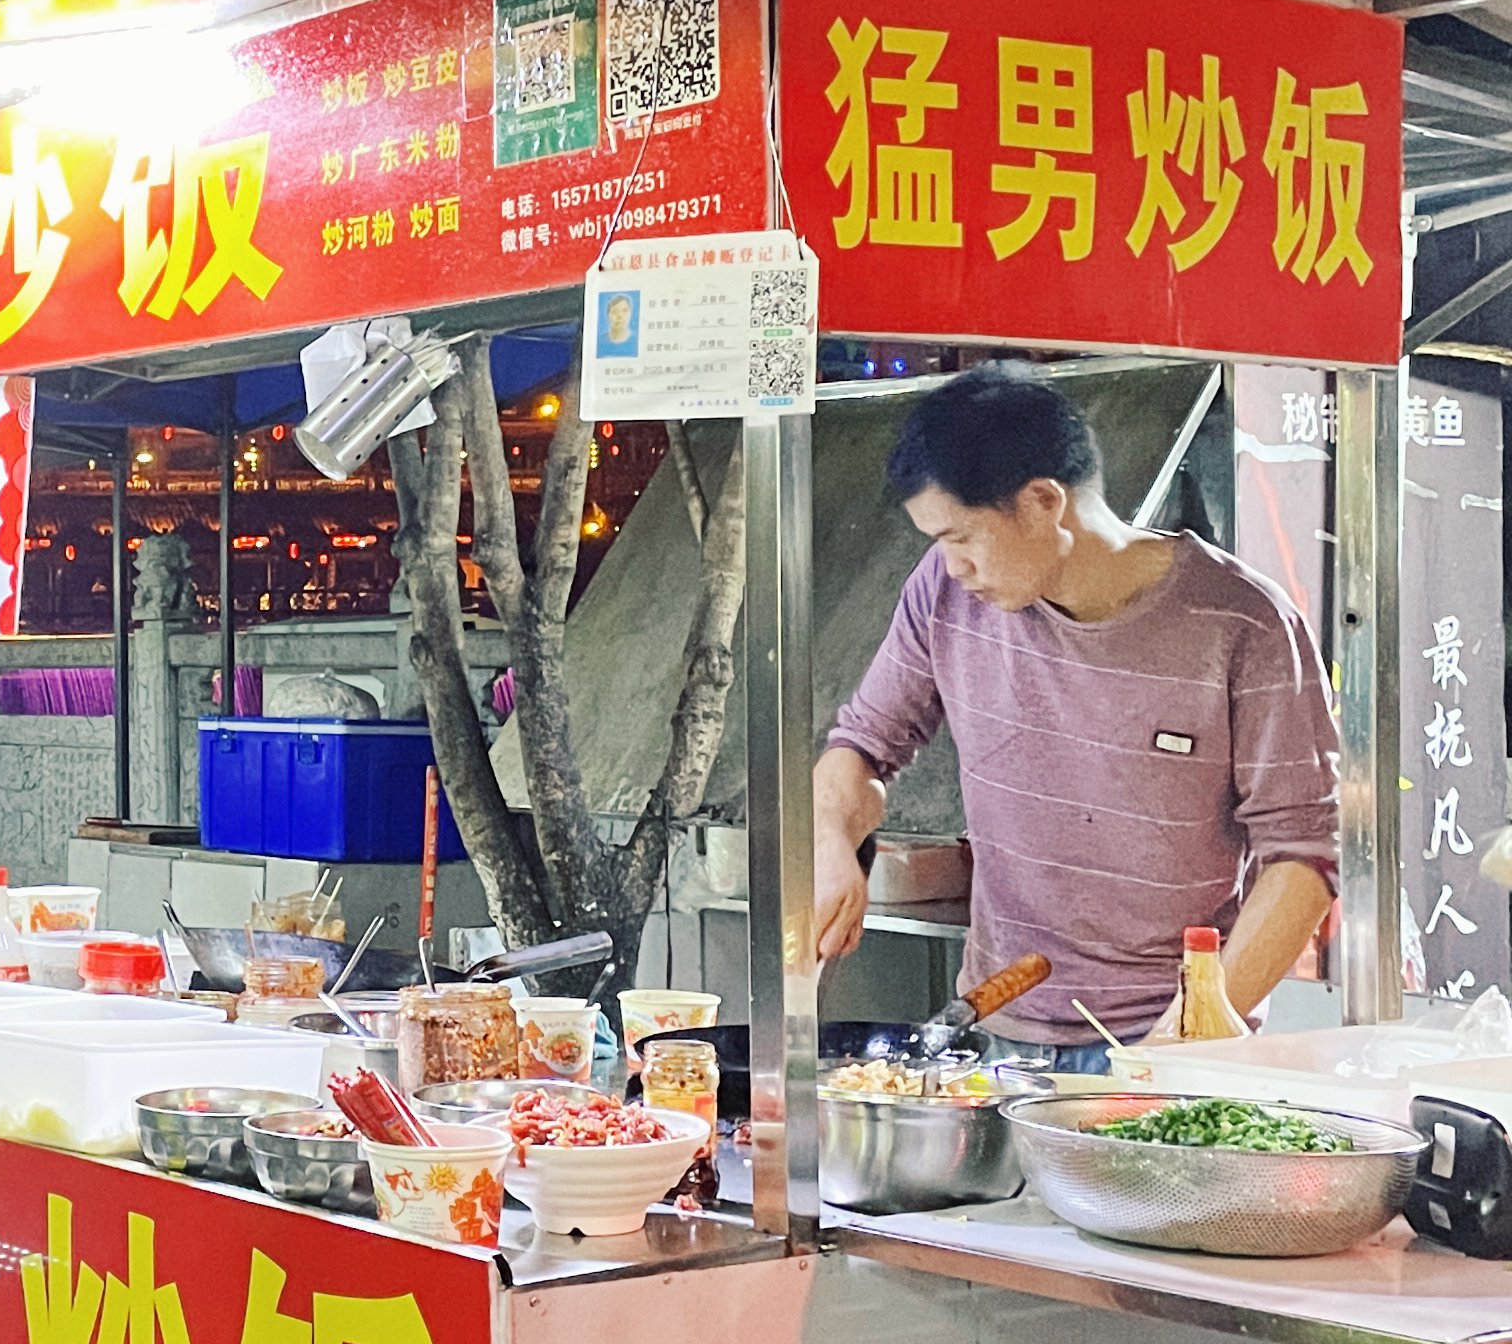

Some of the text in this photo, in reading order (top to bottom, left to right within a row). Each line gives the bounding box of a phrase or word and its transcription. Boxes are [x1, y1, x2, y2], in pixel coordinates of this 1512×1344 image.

[320, 47, 458, 116] 炒饭 炒豆皮
[320, 121, 461, 185] 炒广东米粉
[825, 16, 1375, 288] 猛男炒饭
[321, 195, 461, 255] 炒河粉 炒面
